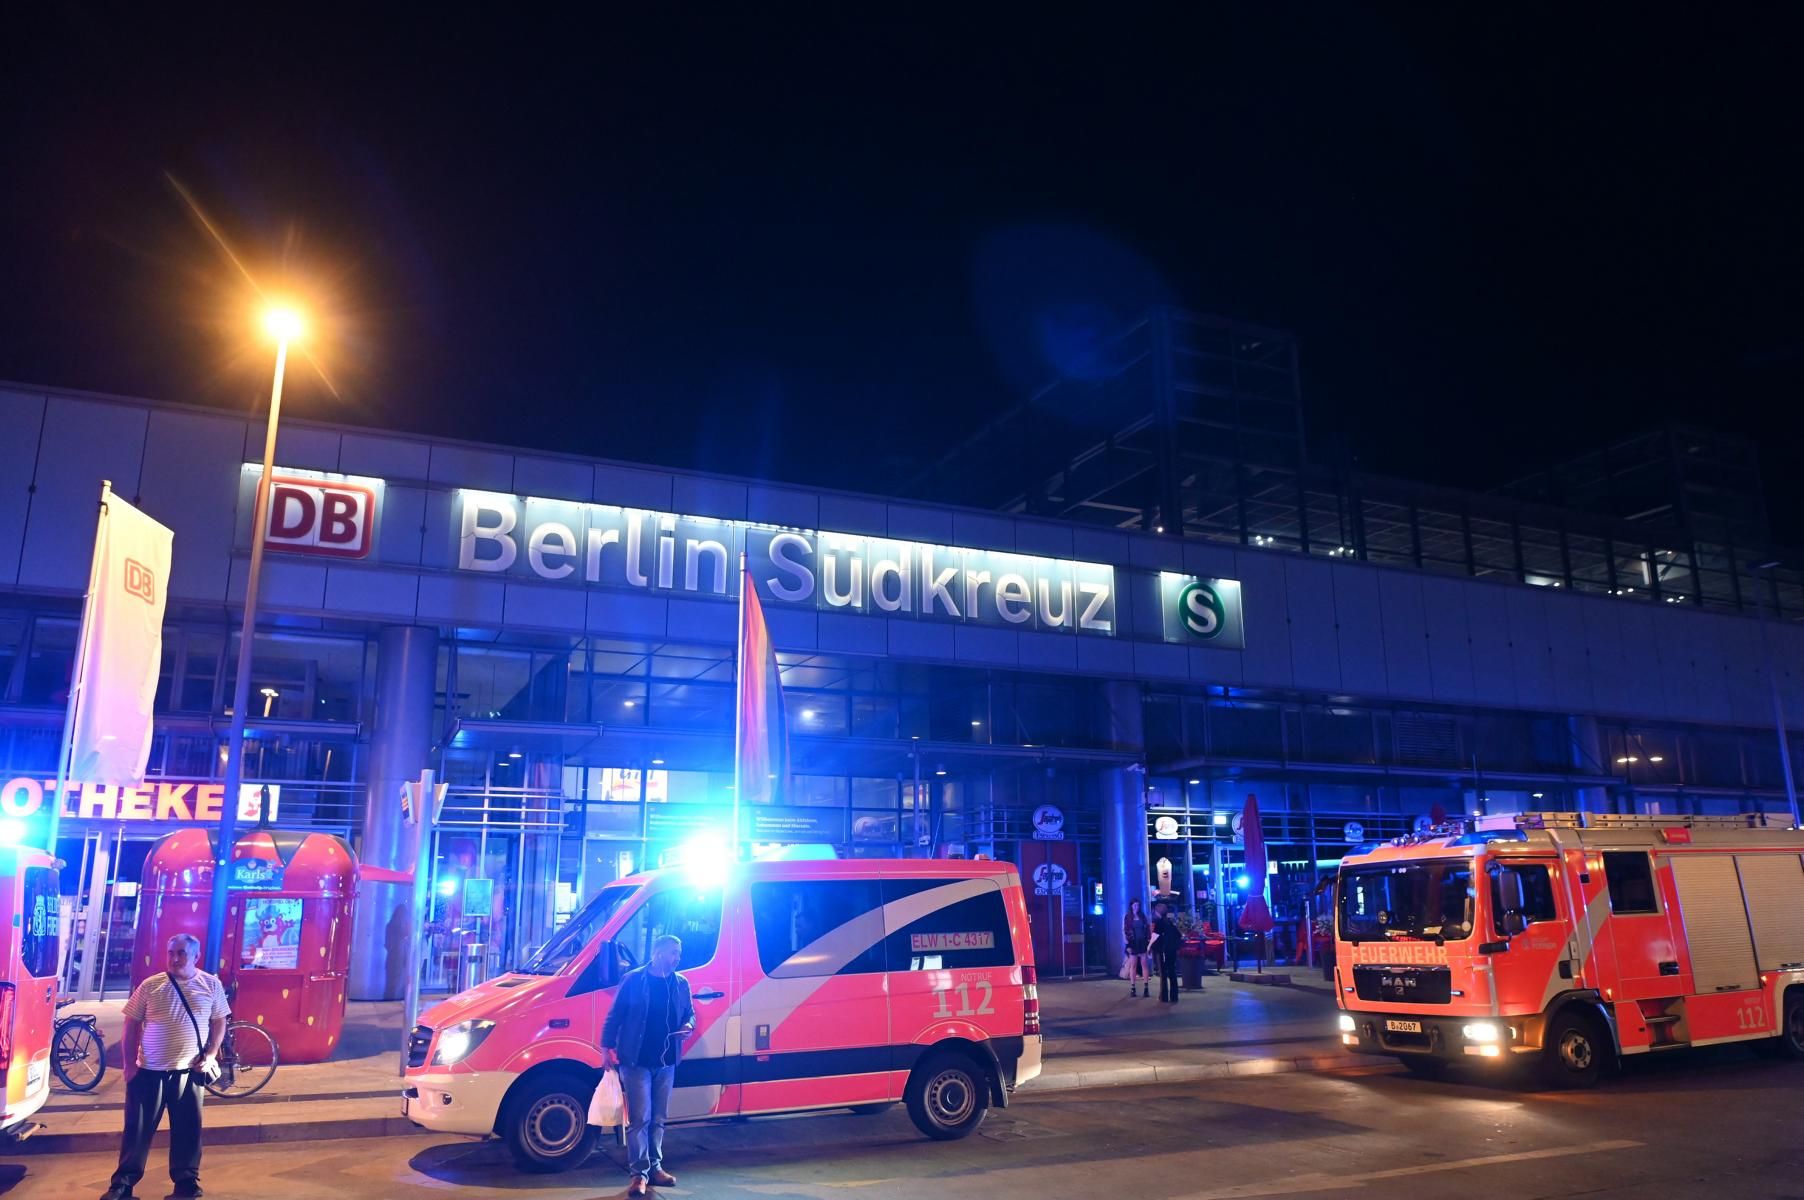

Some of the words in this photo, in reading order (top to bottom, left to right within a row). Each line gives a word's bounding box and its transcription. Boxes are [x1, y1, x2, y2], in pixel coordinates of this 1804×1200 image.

[270, 487, 358, 544] DB
[458, 498, 728, 594] Berlin
[766, 533, 1112, 631] Südkreuz
[129, 566, 151, 597] DB
[1185, 588, 1218, 634] S
[236, 869, 266, 880] Karls
[912, 933, 939, 949] ELW
[943, 932, 961, 947] 1-C
[964, 931, 990, 946] 4317
[1351, 946, 1448, 964] FEUERWEHR
[960, 972, 992, 982] NOTRUF
[1381, 977, 1416, 987] MAN
[932, 981, 995, 1018] 112
[1398, 1022, 1416, 1031] 2067
[1737, 1005, 1765, 1030] 112
